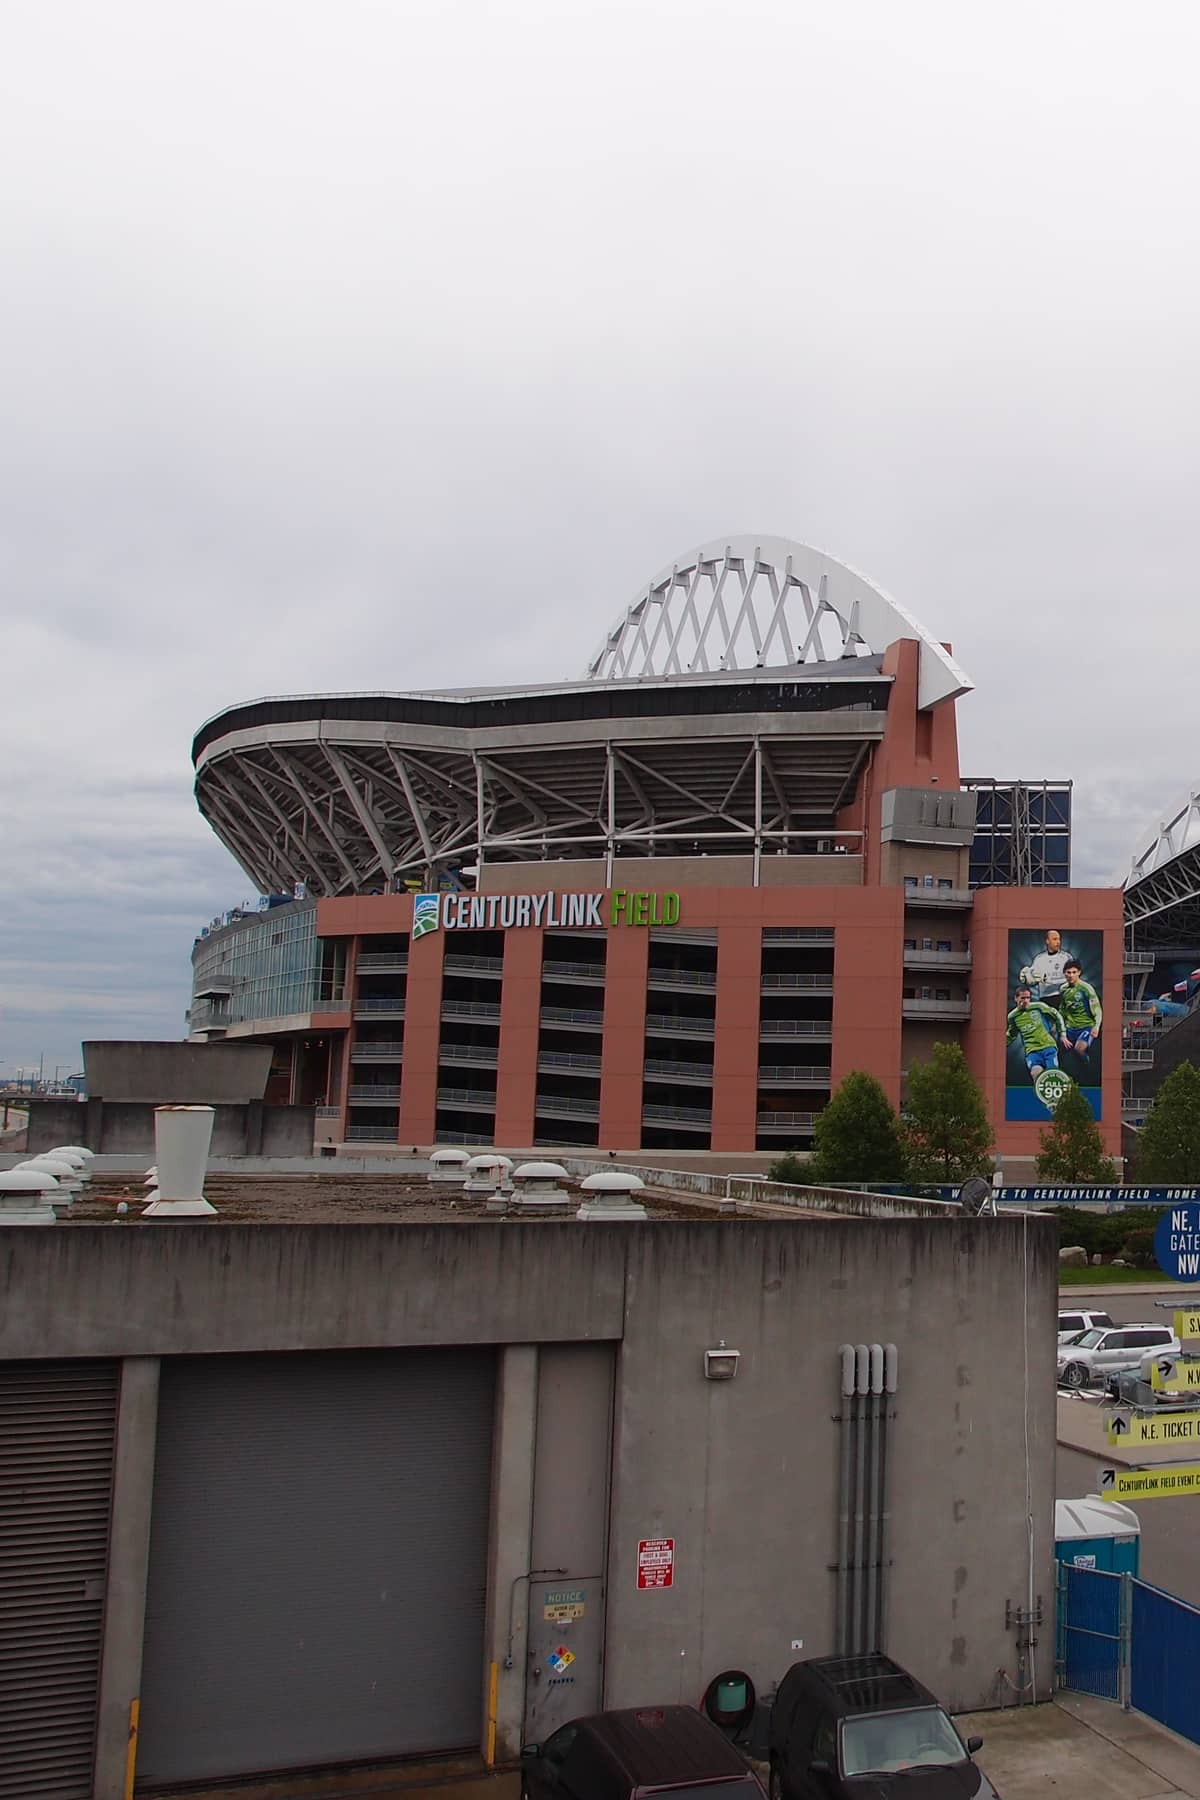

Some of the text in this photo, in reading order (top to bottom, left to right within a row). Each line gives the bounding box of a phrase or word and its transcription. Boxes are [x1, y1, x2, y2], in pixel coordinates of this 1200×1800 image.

[443, 889, 680, 929] CENTURYLINK FIELD
[1044, 1087, 1062, 1098] 90
[1014, 1189, 1026, 1199] TO
[1034, 1189, 1112, 1199] CENTURYLINK
[1118, 1189, 1150, 1199] FIELD
[1166, 1189, 1197, 1200] HOME
[1171, 1210, 1193, 1232] NE,
[1178, 1254, 1199, 1275] NW
[1141, 1424, 1159, 1441] N.E.
[1163, 1421, 1193, 1438] TICKET
[1160, 1477, 1176, 1489] FIELD
[1177, 1475, 1194, 1487] EVENT
[548, 1591, 582, 1602] NOTICE
